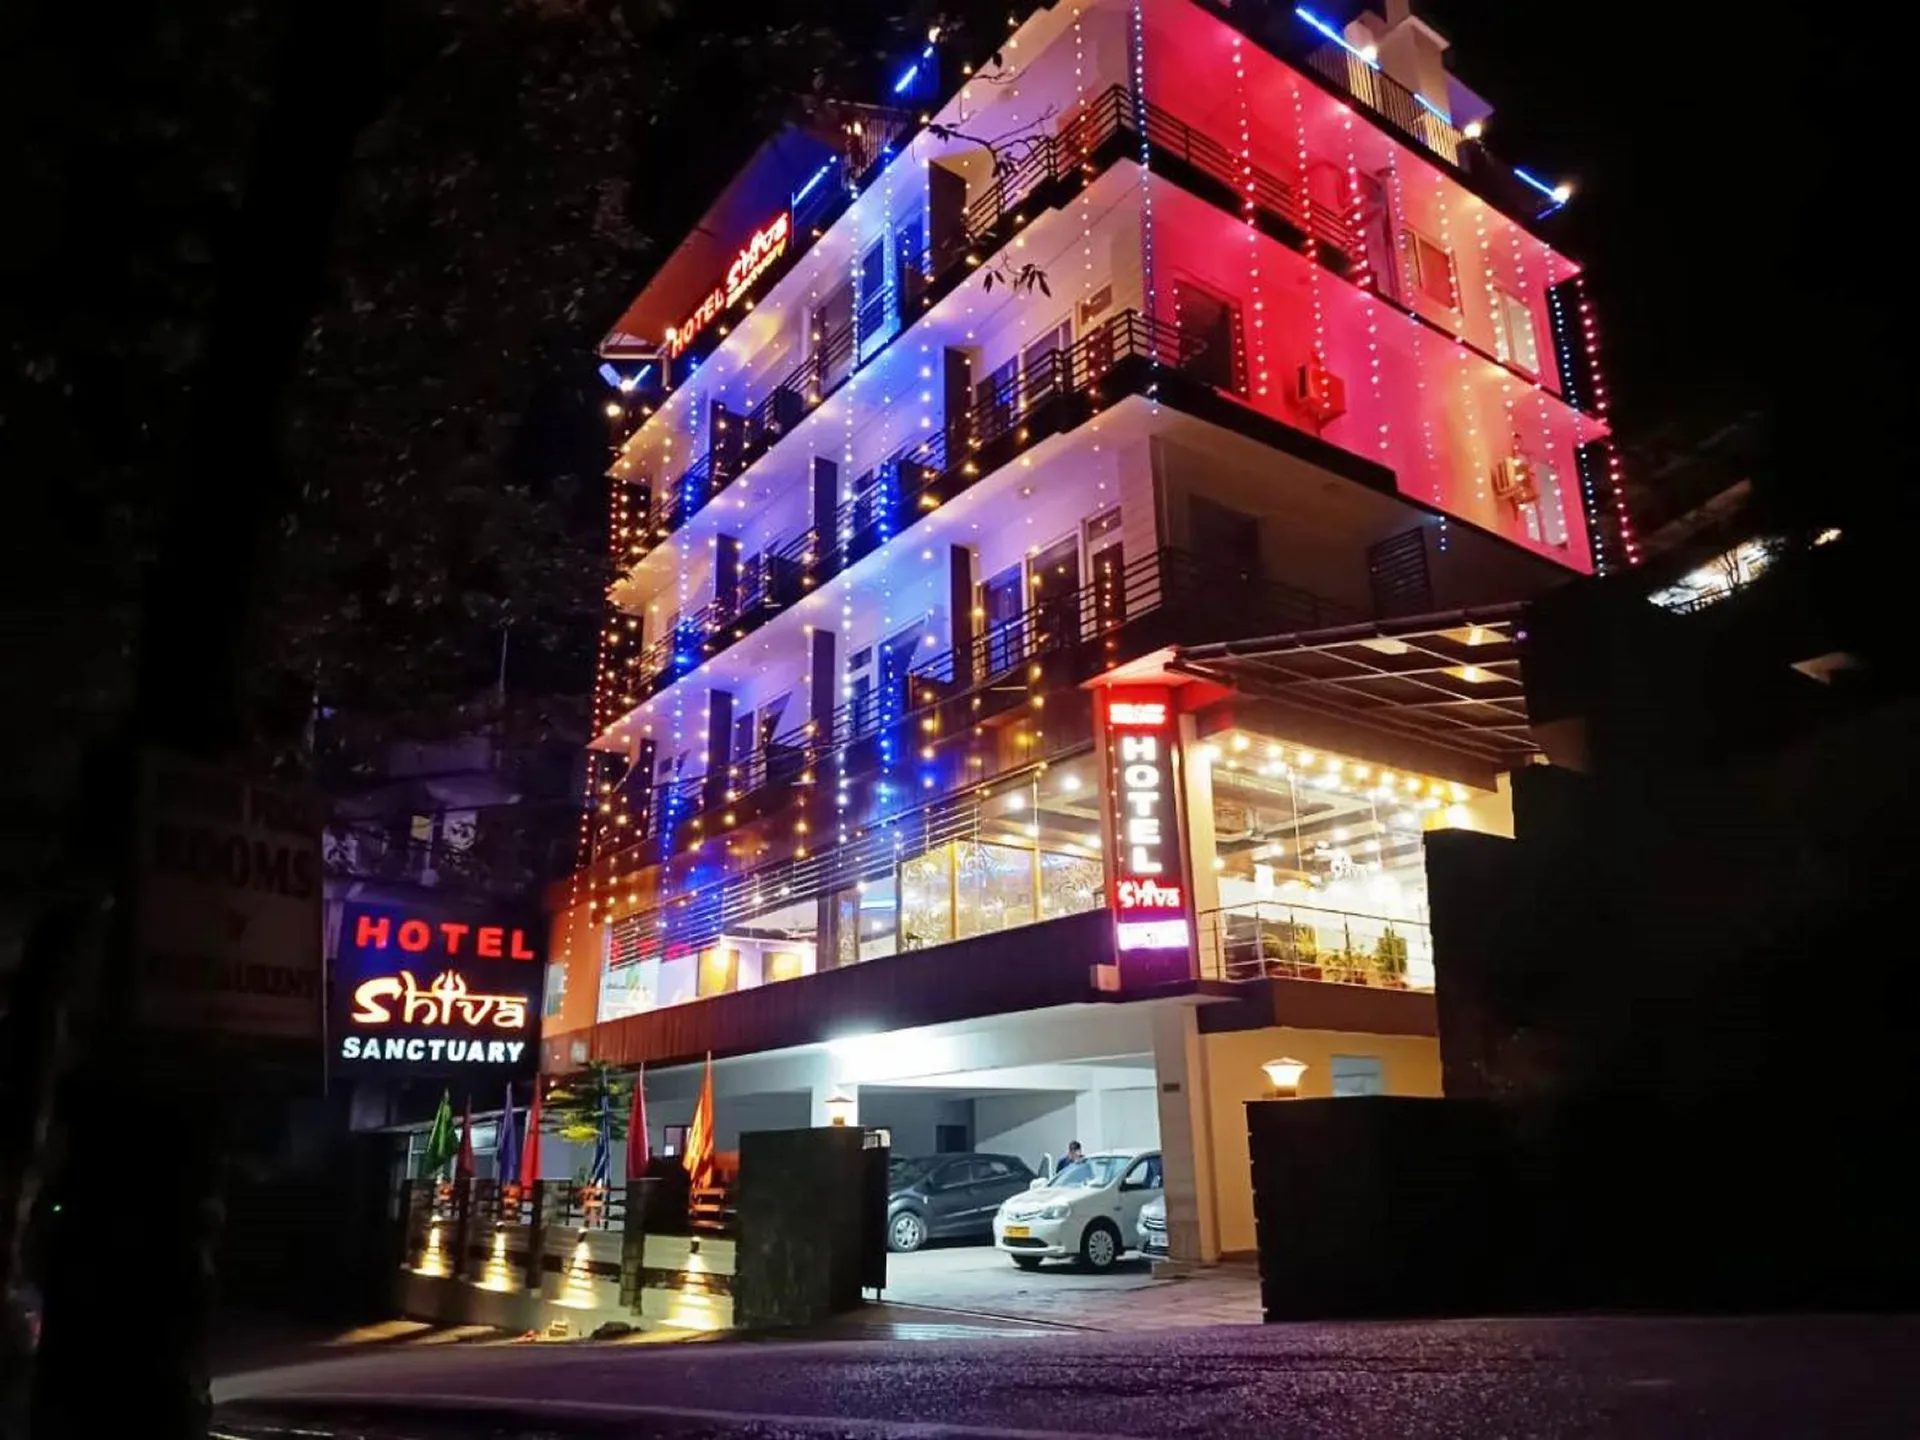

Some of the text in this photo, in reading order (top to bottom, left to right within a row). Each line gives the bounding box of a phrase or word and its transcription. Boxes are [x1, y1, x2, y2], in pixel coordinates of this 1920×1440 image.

[671, 287, 725, 359] HOTEL
[1121, 735, 1164, 875] HOTEL
[355, 915, 535, 961] HOTEL
[351, 968, 529, 1029] Shiva
[341, 1036, 525, 1063] SANCTUARY
